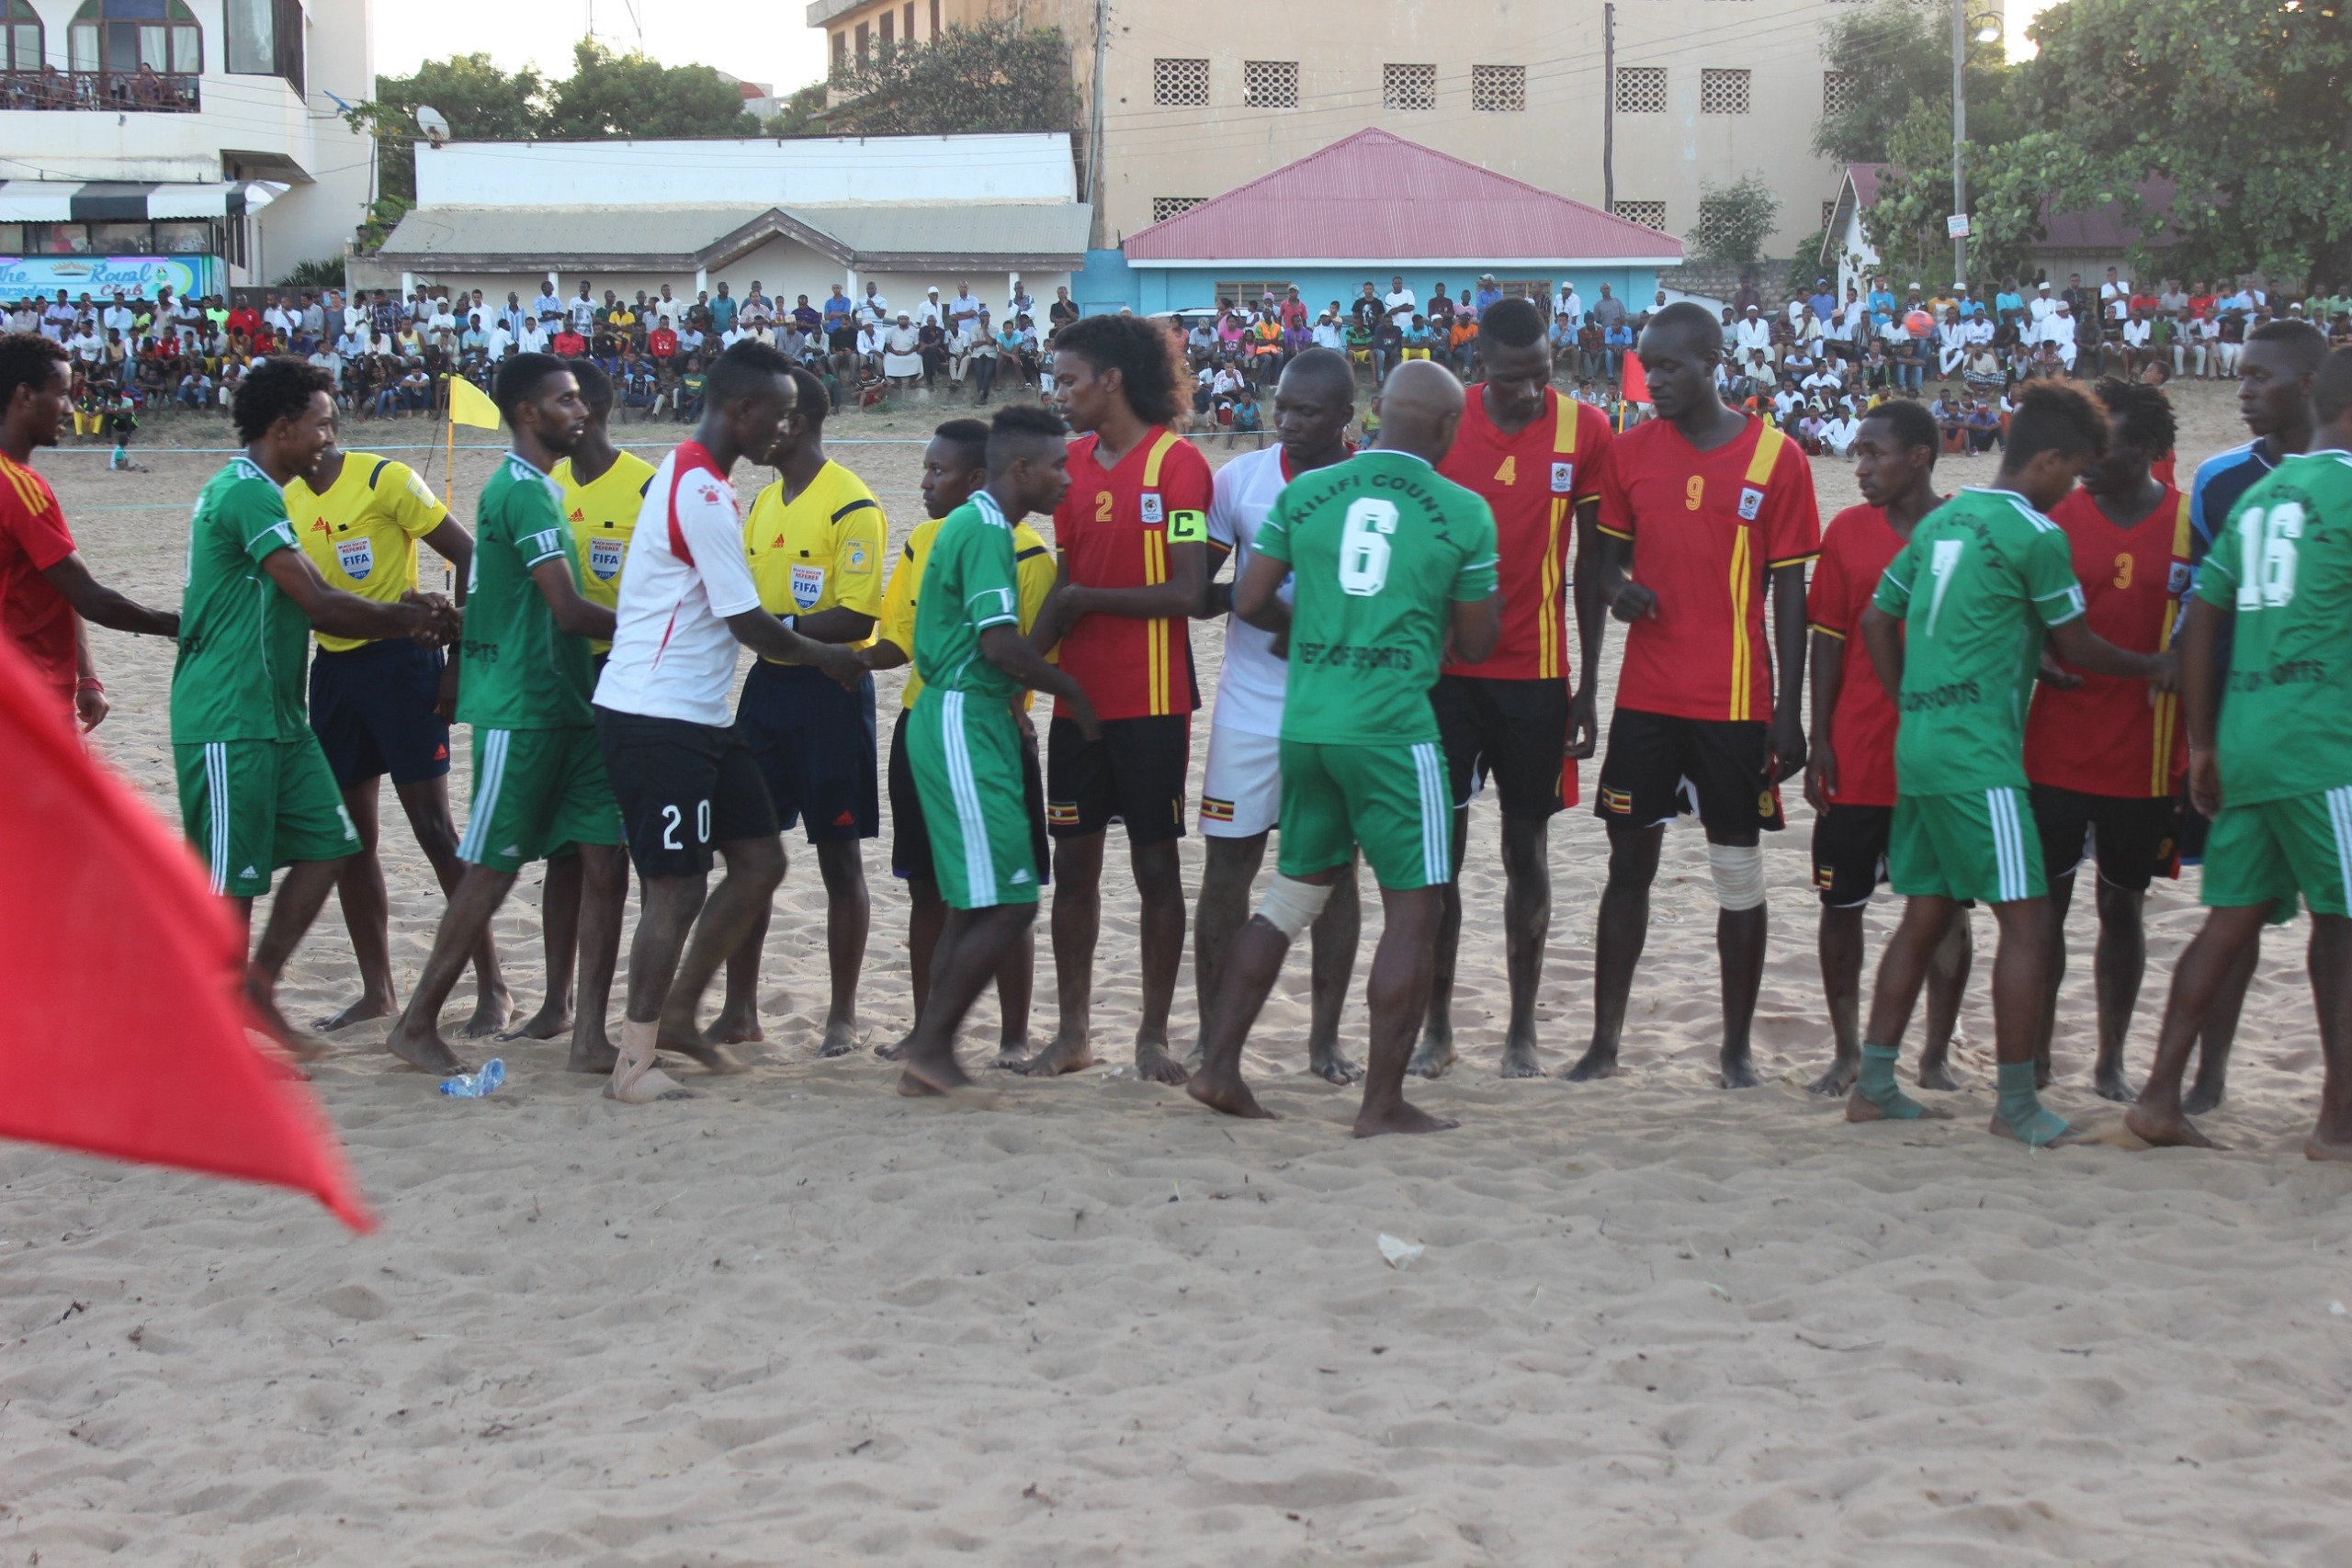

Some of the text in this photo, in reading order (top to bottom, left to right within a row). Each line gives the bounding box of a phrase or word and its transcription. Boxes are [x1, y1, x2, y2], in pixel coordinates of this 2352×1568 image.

[1494, 456, 1517, 486] 4
[1095, 491, 1114, 523] 2
[1685, 475, 1704, 511] 9
[1173, 512, 1194, 537] C
[1290, 473, 1452, 546] KILIFI COUNTY
[342, 545, 367, 555] REFEREE
[343, 553, 369, 567] FIFA
[593, 553, 618, 564] FIFA
[1338, 496, 1399, 597] 6
[2235, 502, 2305, 612] 16
[793, 581, 818, 593] FIFA
[795, 572, 820, 581] REFEREE
[2113, 553, 2133, 590] 3
[1925, 538, 1964, 637] 7
[1758, 790, 1774, 818] 9
[662, 798, 711, 851] 20
